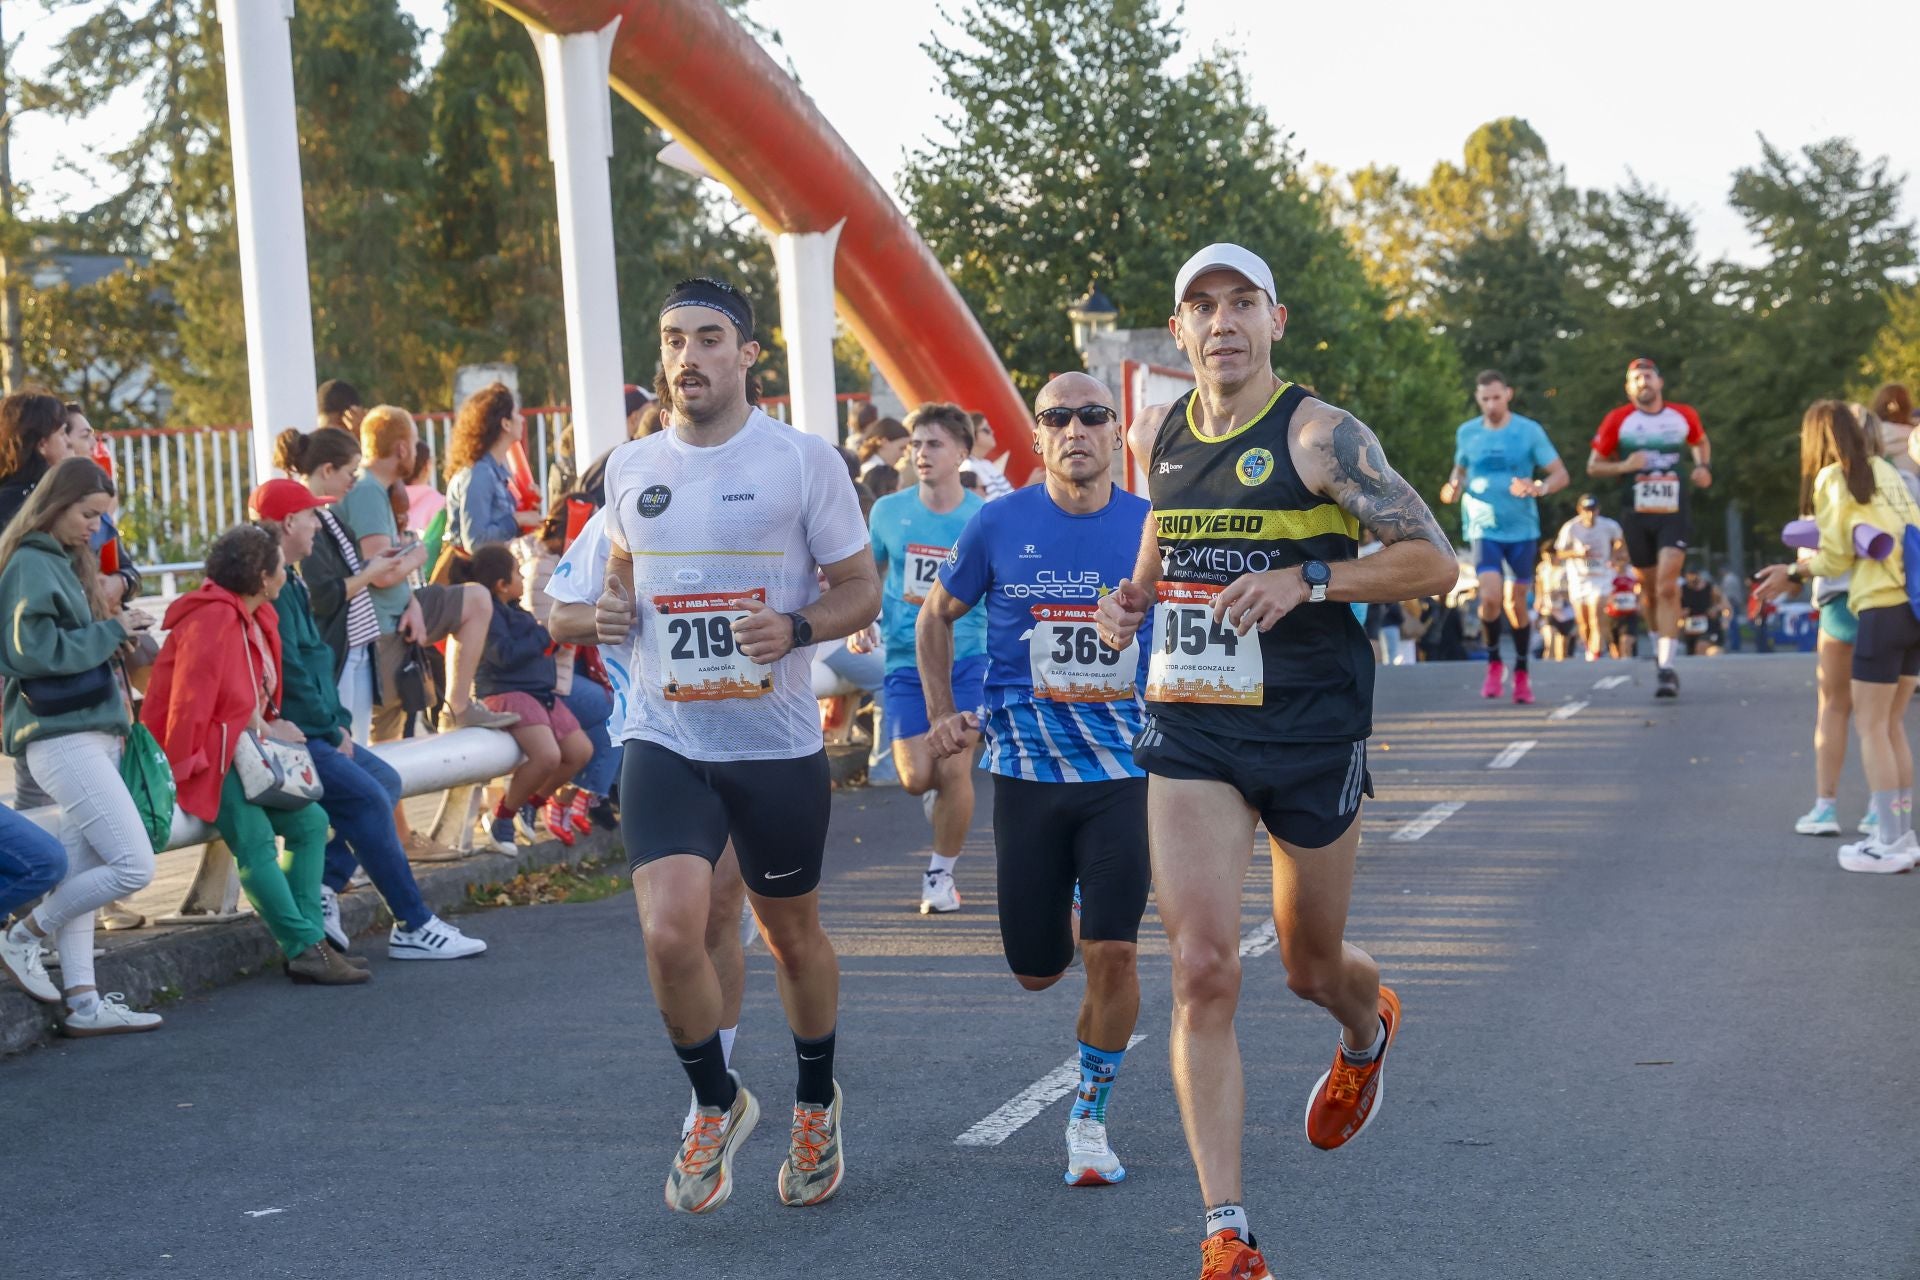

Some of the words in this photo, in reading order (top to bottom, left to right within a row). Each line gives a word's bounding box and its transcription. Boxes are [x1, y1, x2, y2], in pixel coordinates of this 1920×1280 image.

[722, 494, 755, 502] VESKIN
[915, 558, 945, 583] 12
[1036, 570, 1100, 584] CLUB
[1173, 570, 1228, 582] AYUNTAMIENTO
[686, 600, 709, 608] MBA
[1065, 610, 1087, 618] MBA
[698, 664, 720, 672] AARÓN
[721, 663, 736, 671] DÍAZ
